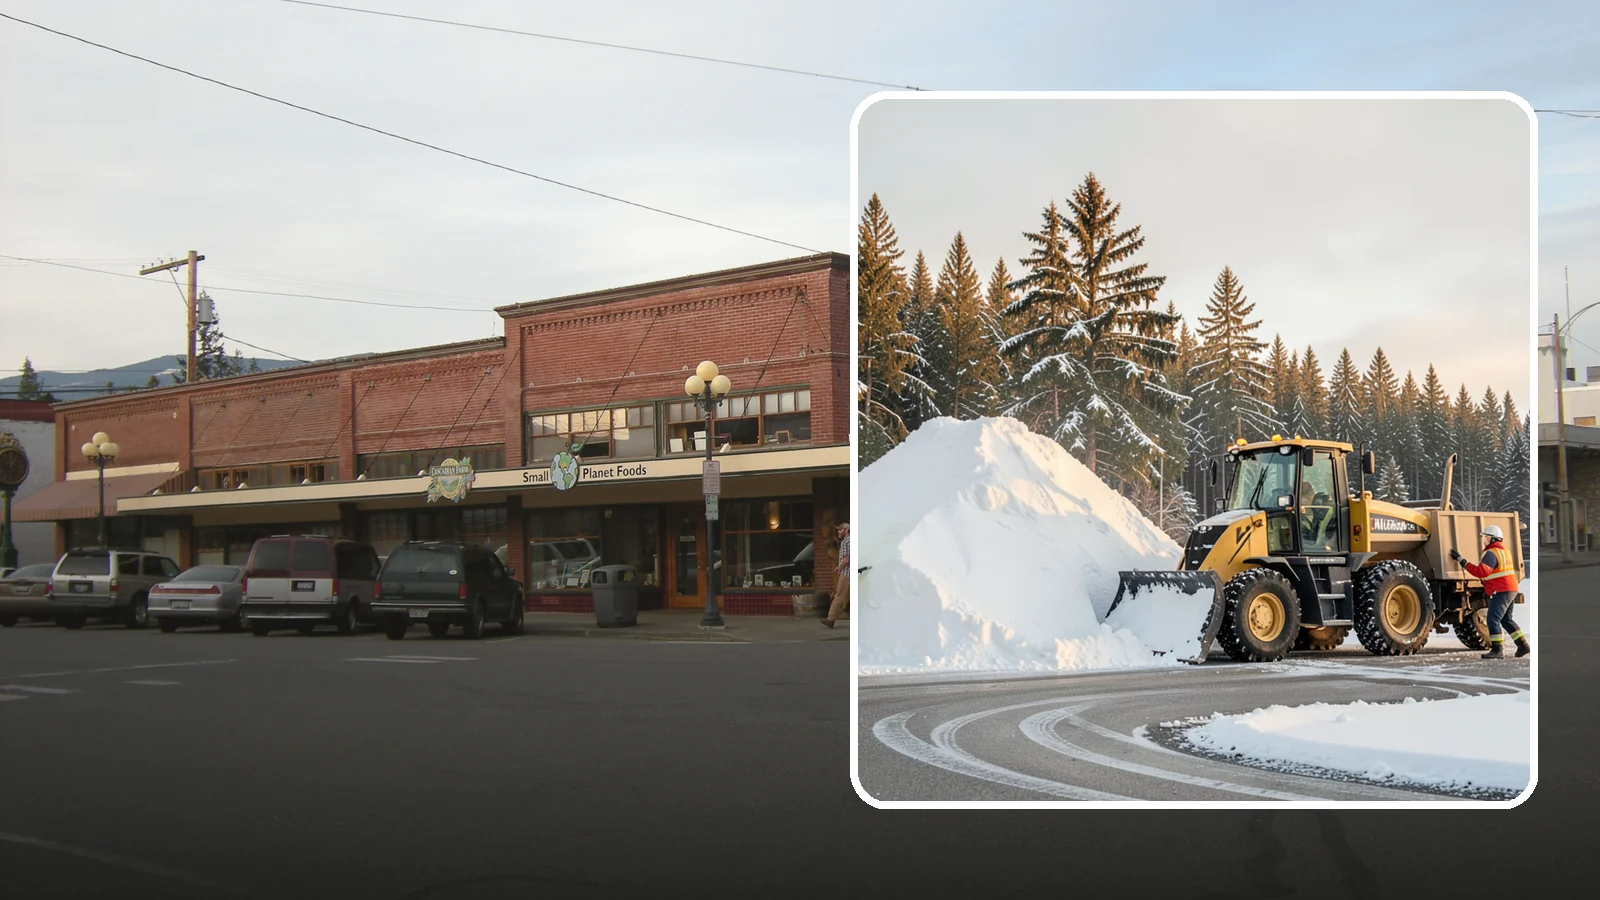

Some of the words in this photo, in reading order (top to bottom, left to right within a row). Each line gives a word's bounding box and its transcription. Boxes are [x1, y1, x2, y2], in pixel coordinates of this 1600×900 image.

[432, 467, 455, 476] CASCADIAN
[523, 471, 548, 483] Small
[583, 468, 614, 479] Planet
[617, 464, 647, 477] Foods
